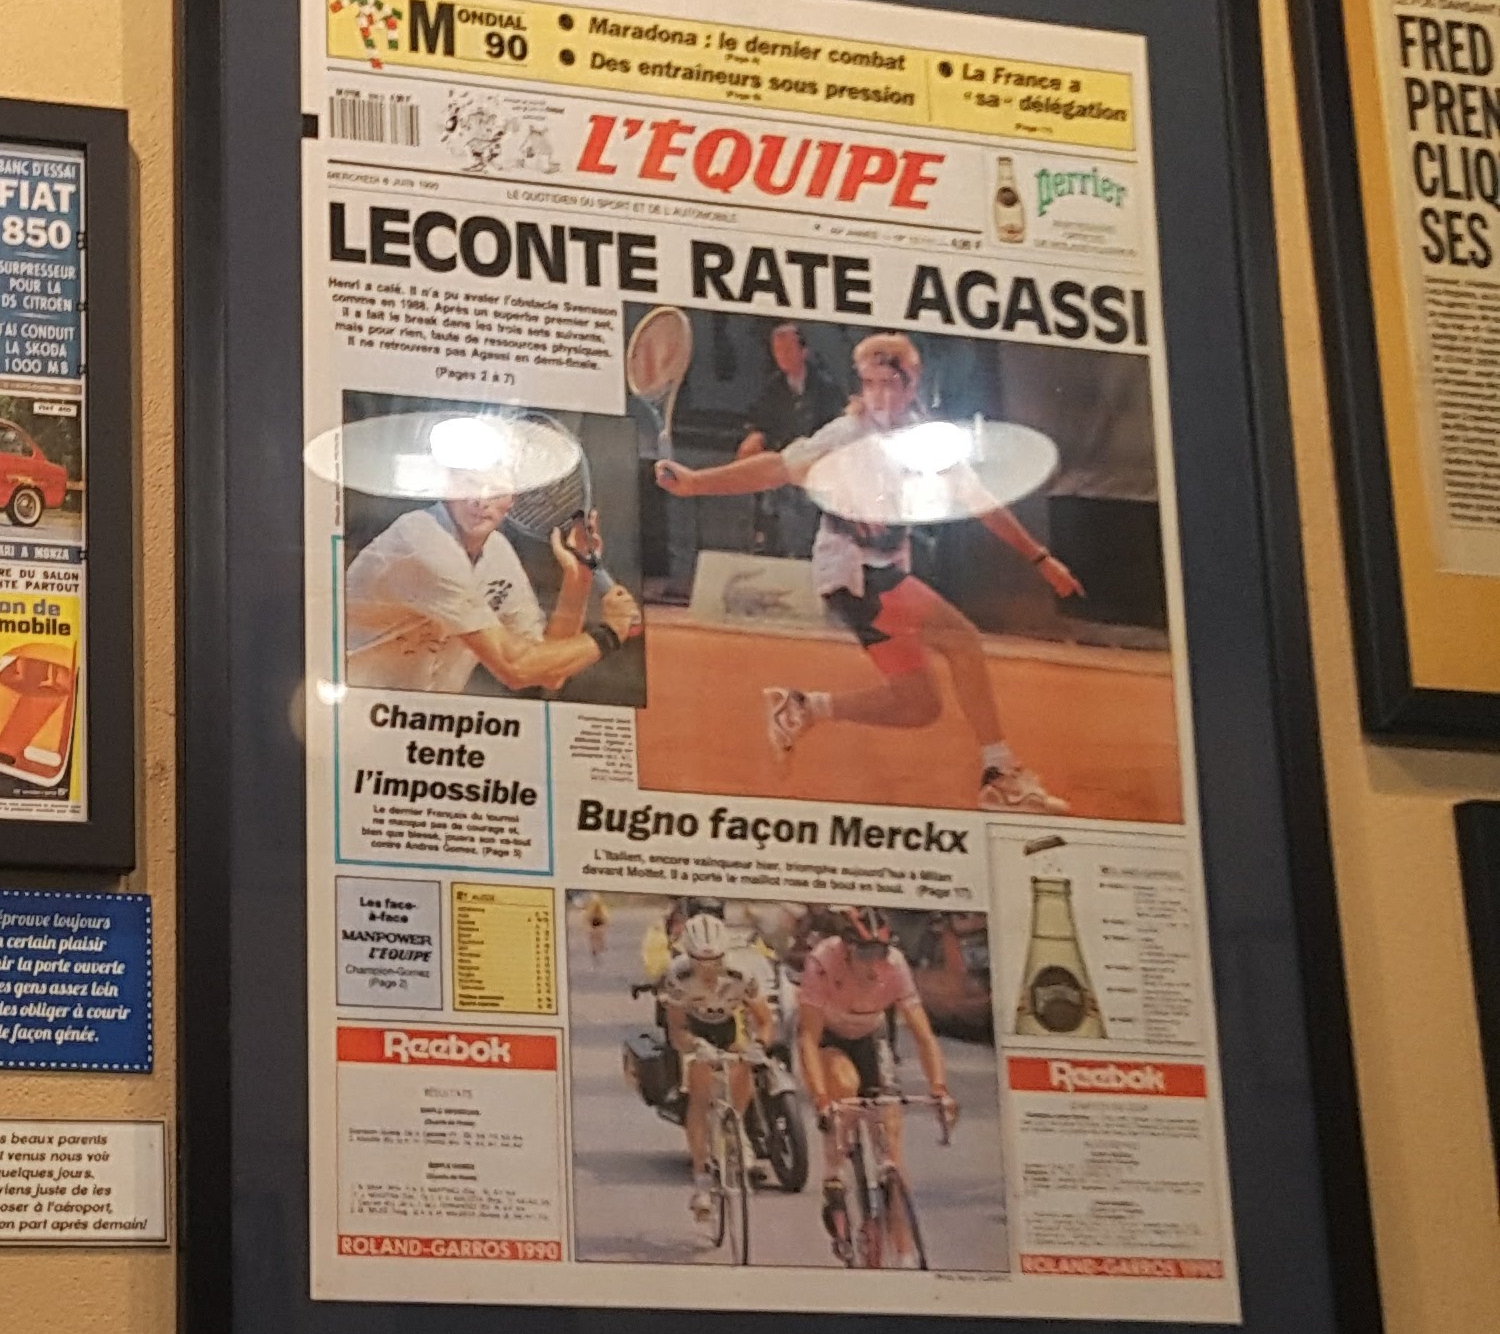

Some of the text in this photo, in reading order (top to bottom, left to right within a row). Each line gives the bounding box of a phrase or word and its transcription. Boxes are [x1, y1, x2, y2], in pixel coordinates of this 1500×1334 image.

[485, 33, 528, 62] 90
[589, 16, 906, 72] Maradona le dernier combat
[1400, 15, 1494, 78] FRED
[1036, 167, 1128, 218] perrier
[2, 216, 72, 251] 850
[1421, 207, 1493, 269] SES
[329, 201, 1148, 347] LECONTE RATE AGASSI
[32, 598, 62, 617] de
[370, 702, 520, 738] Champion
[407, 741, 485, 769] tente
[354, 769, 538, 807] l'impossible
[578, 799, 969, 855] Bugno façon Merckx
[53, 913, 111, 932] toujours
[6, 935, 57, 950] certain
[58, 935, 107, 954] plaisir
[384, 1031, 511, 1064] Reebok
[1049, 1060, 1166, 1094] Reebok
[8, 1152, 46, 1162] venus
[50, 1152, 82, 1162] nous
[87, 1151, 110, 1162] voir
[11, 1132, 53, 1145] beaux
[57, 1134, 108, 1147] parents
[340, 1236, 559, 1260] ROLAND-GARROS 1990
